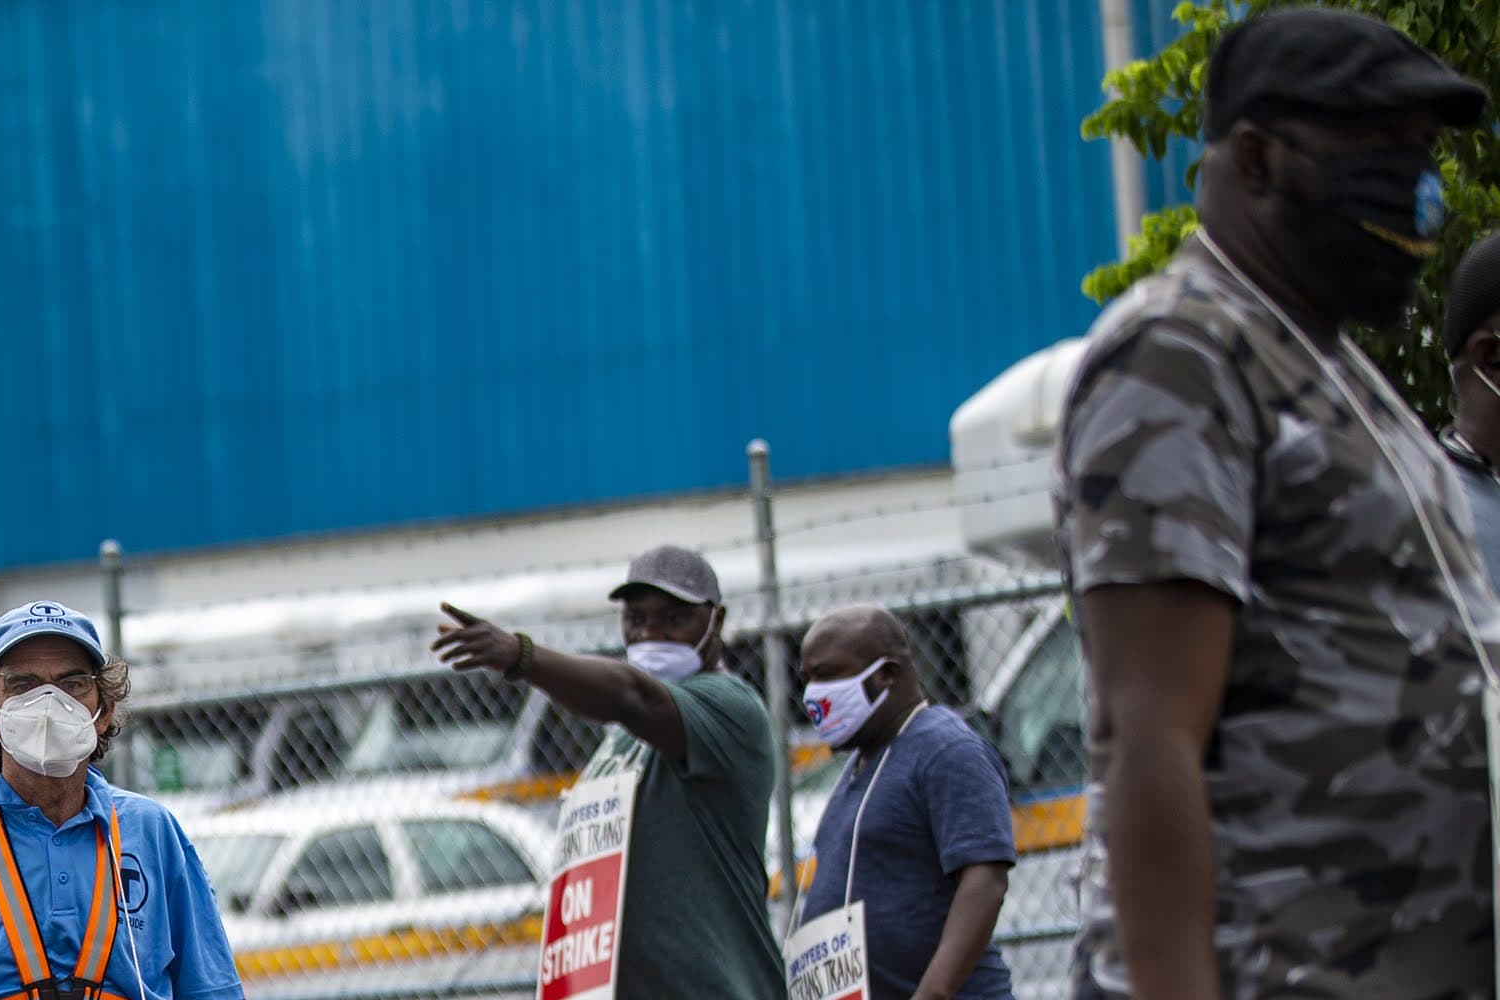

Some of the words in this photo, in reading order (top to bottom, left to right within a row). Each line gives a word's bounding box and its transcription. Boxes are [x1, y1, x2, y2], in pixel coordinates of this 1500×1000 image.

[561, 877, 592, 926] ON
[542, 920, 614, 986] STRIKE
[822, 947, 863, 994] TRANS
